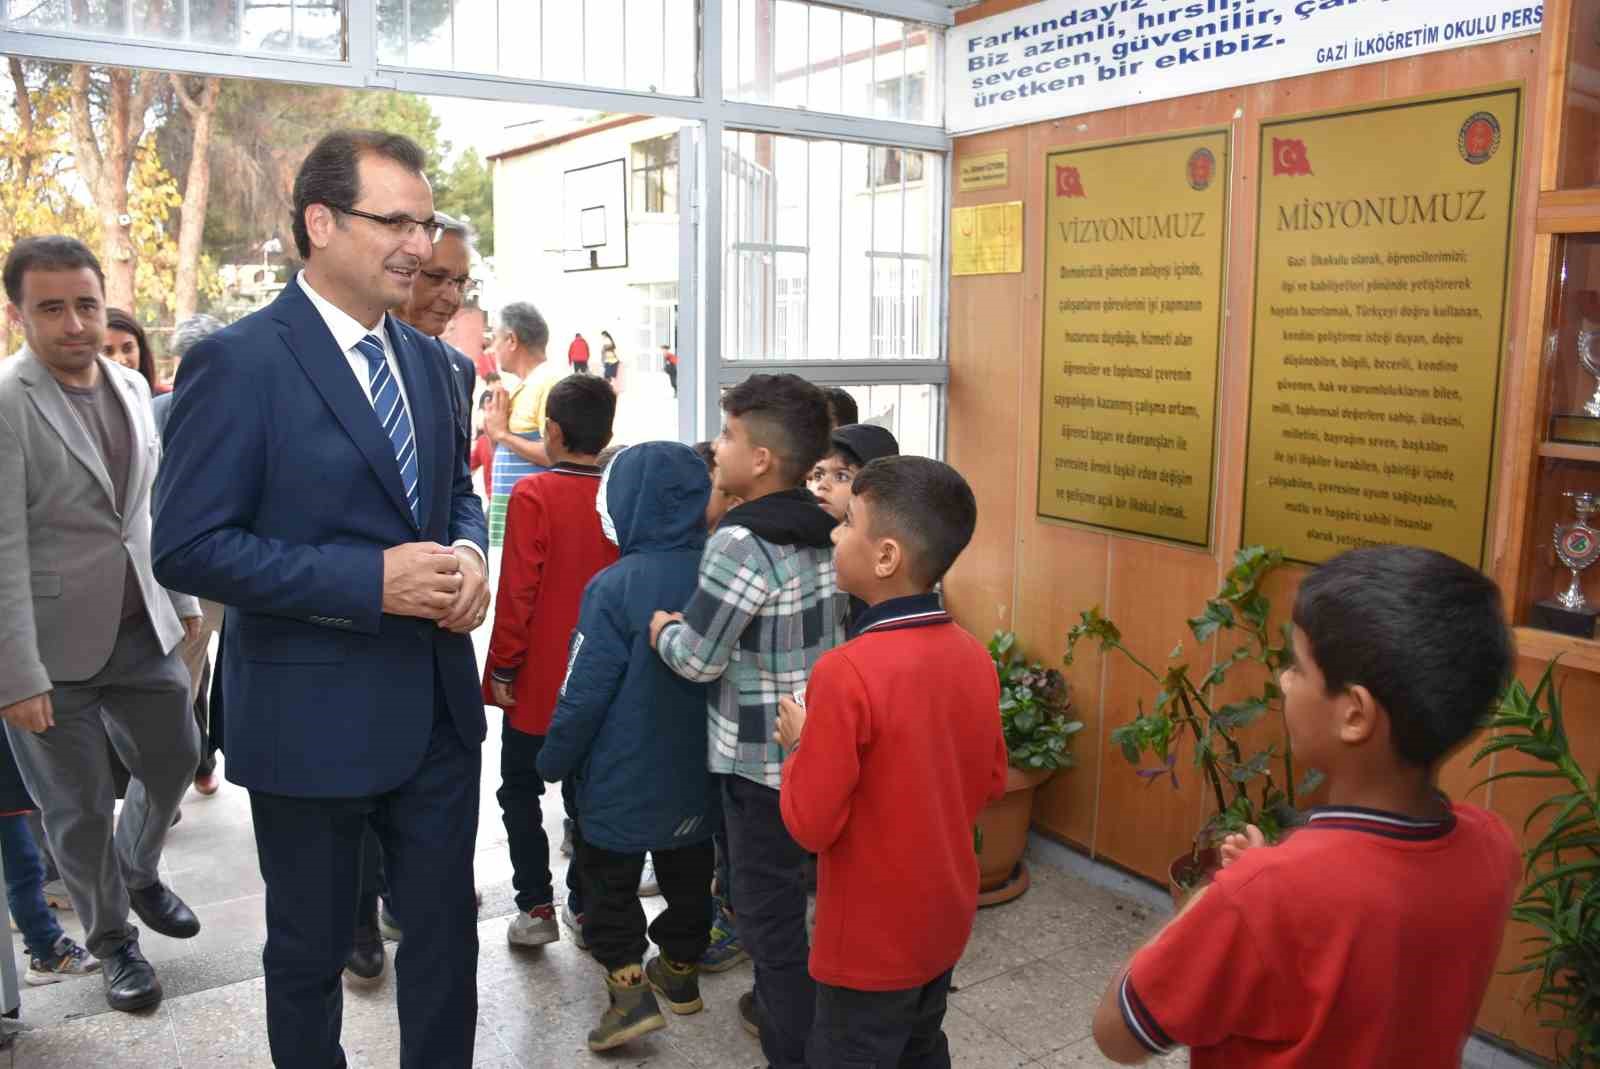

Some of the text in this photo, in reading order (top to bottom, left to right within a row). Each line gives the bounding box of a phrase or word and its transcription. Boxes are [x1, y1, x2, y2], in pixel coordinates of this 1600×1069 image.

[1316, 5, 1543, 63] GAZİ İLKÖĞRETİM OKULU PERS
[968, 51, 1009, 73] Biz
[1024, 21, 1126, 58] azimli,
[972, 51, 1101, 90] sevecen,
[1112, 9, 1283, 60] güvenilir,
[974, 33, 1286, 108] üretken bir ekibiz.
[1277, 190, 1487, 231] MİSYONUMUZ
[1058, 212, 1206, 244] VİZYONUMUZ
[1297, 281, 1308, 292] ve
[1103, 366, 1112, 377] ve
[1337, 383, 1348, 394] ve
[1115, 432, 1125, 444] ve
[1056, 489, 1065, 499] ve
[1312, 505, 1323, 516] ve
